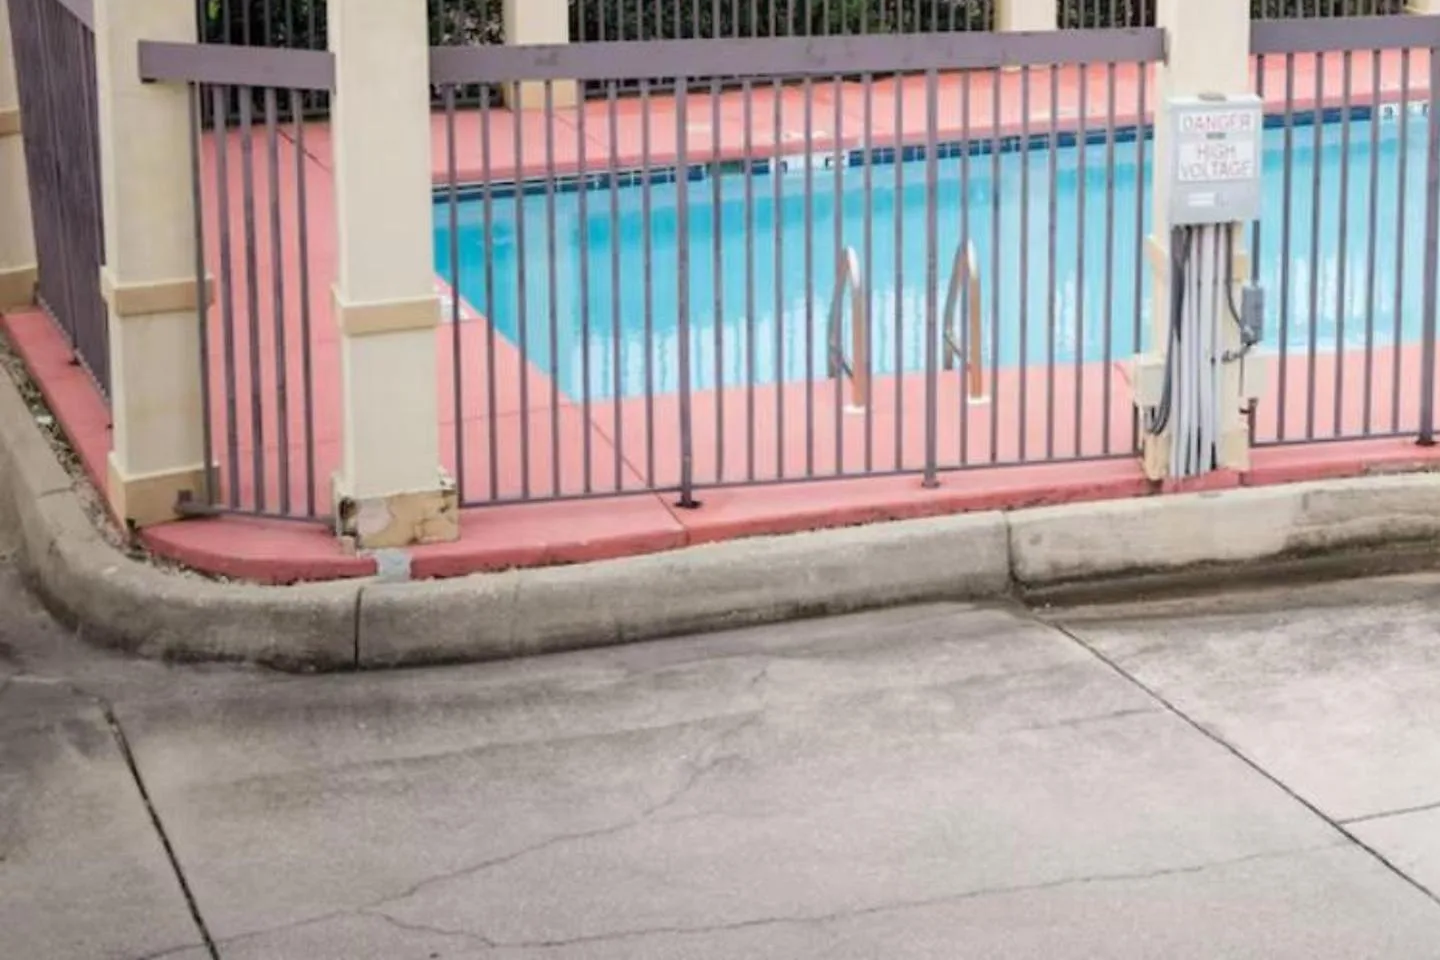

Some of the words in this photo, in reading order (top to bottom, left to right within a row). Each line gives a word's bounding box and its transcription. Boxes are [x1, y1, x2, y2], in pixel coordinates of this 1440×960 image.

[1183, 113, 1251, 131] DANGER
[1197, 143, 1236, 160] HIGH
[1181, 160, 1251, 178] VOLTAGE
